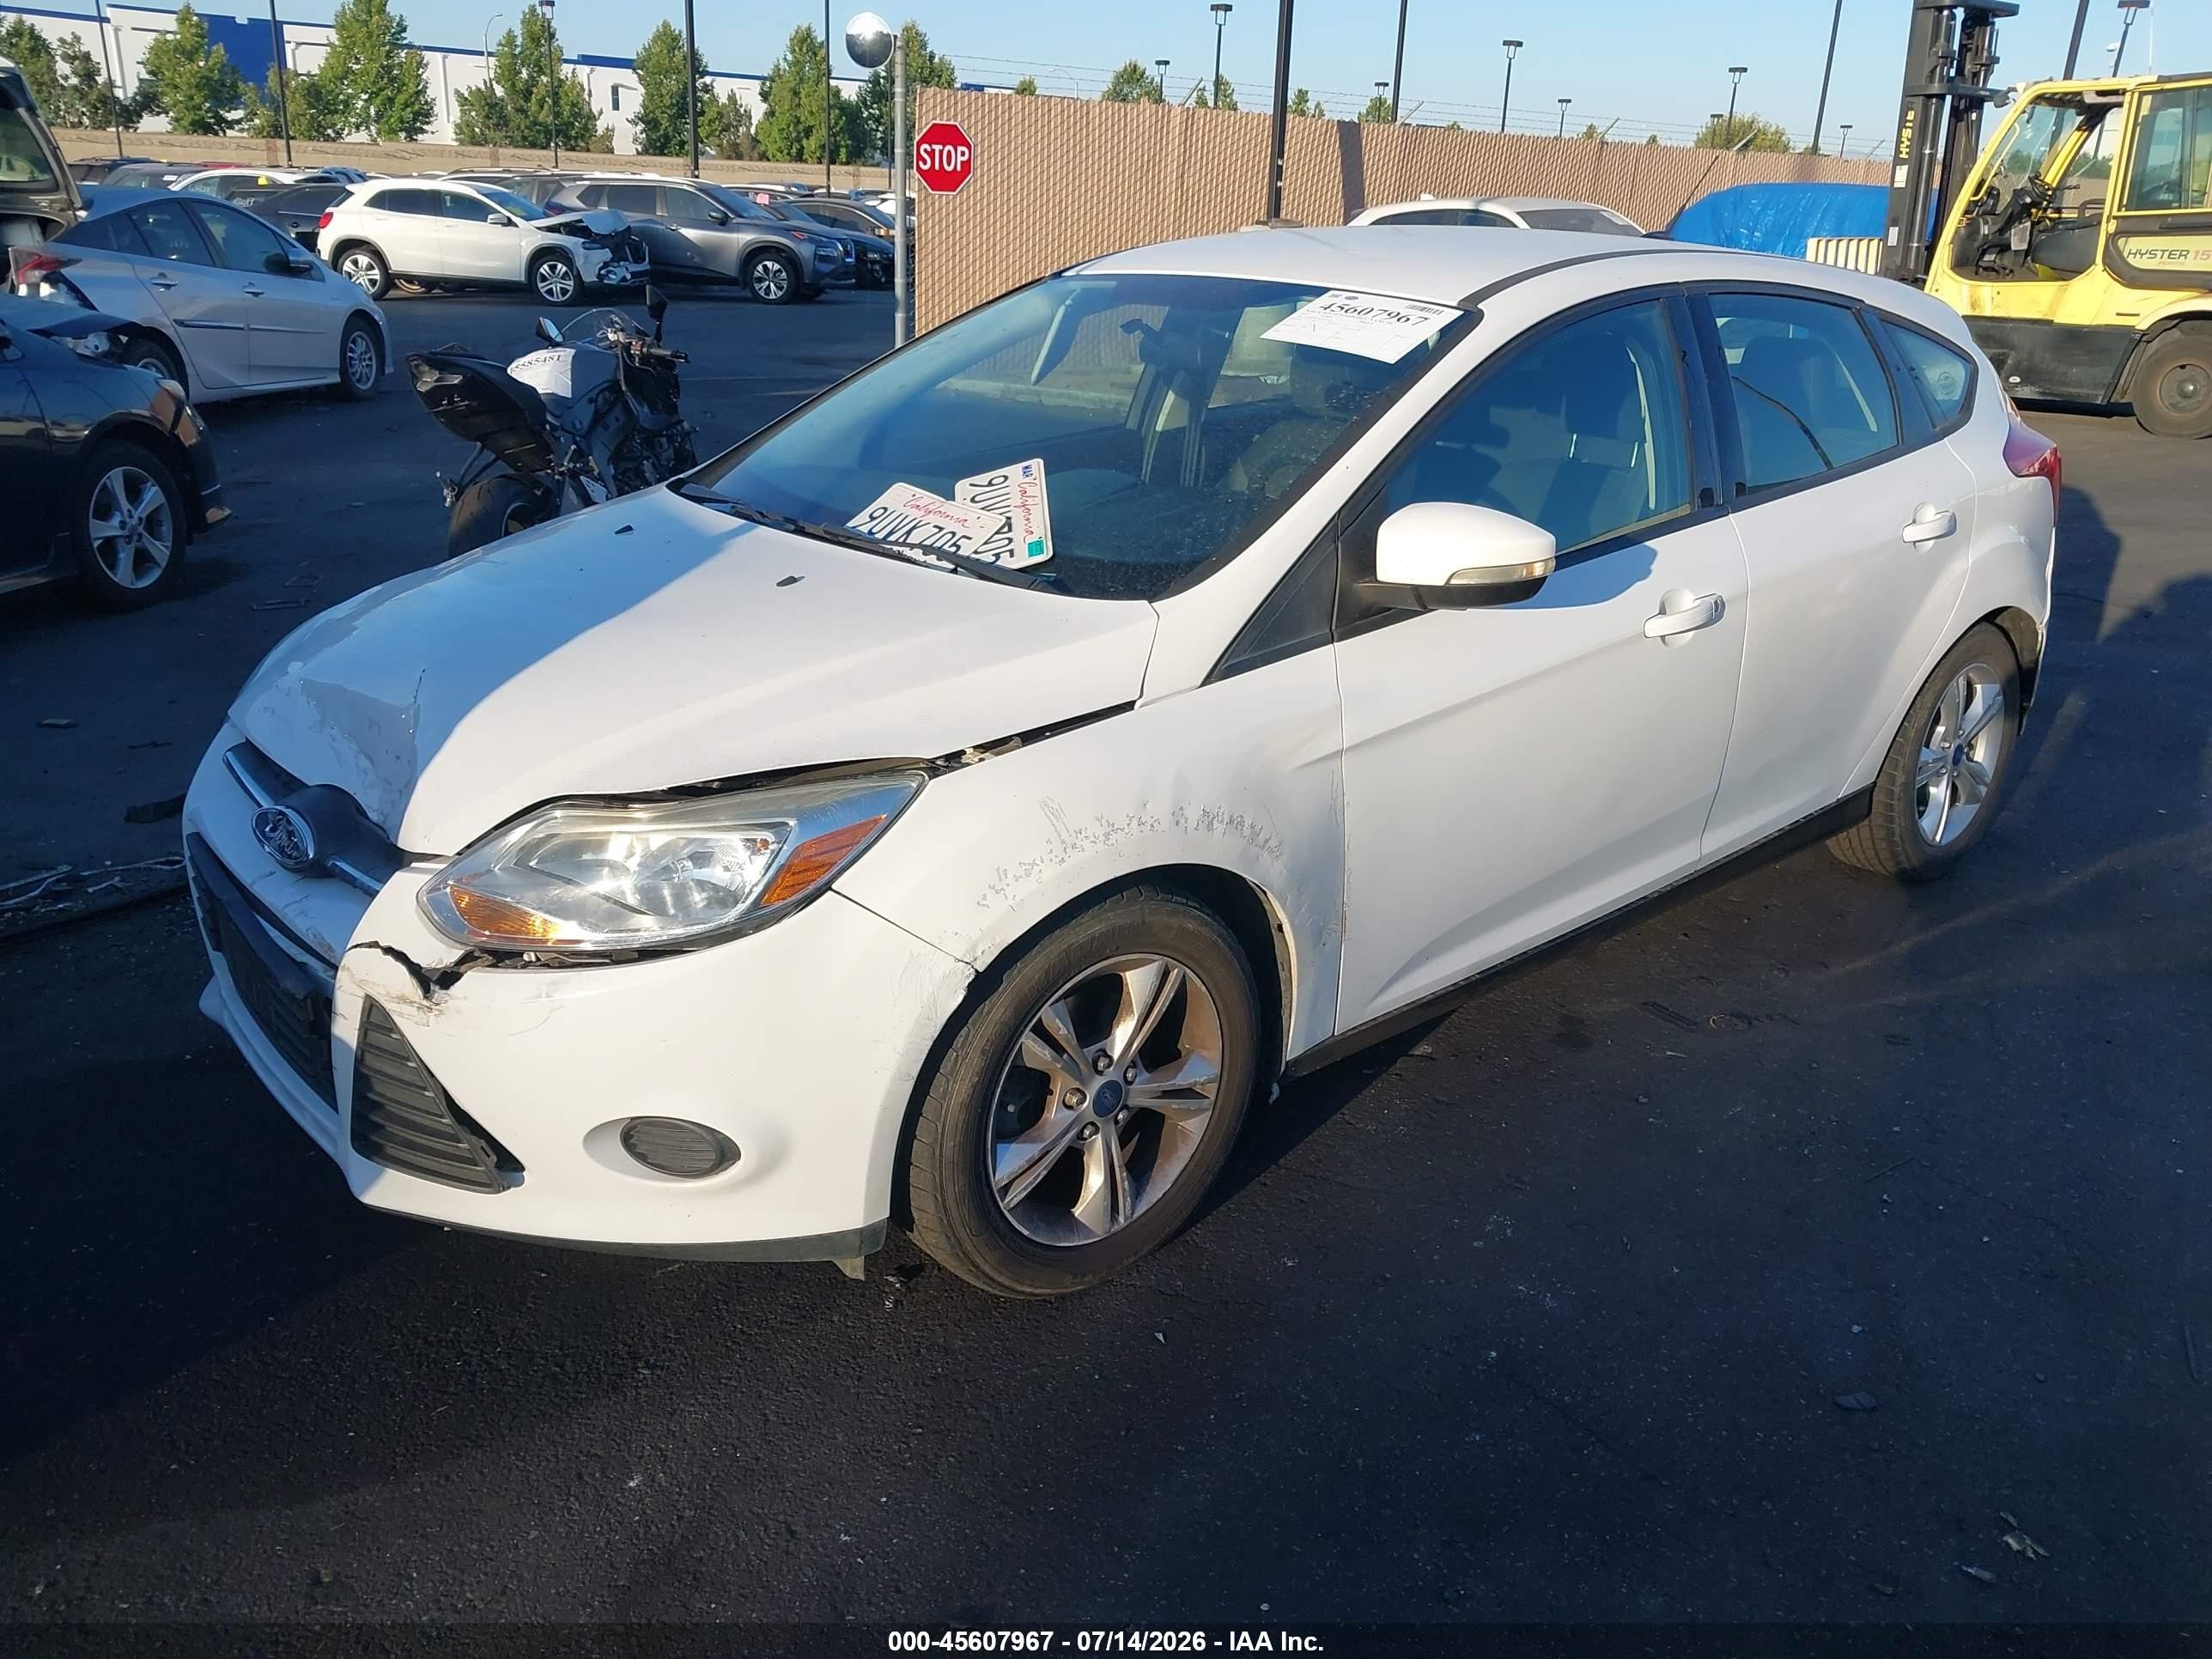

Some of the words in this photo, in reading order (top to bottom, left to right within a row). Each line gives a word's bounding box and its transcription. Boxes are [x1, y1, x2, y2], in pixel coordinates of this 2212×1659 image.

[918, 143, 969, 172] STOP
[2126, 248, 2191, 260] HYSTER
[1319, 301, 1430, 326] 45607967
[1020, 464, 1035, 479] MAR
[902, 494, 970, 529] California
[1014, 481, 1038, 544] California
[852, 506, 973, 555] 9UVK705
